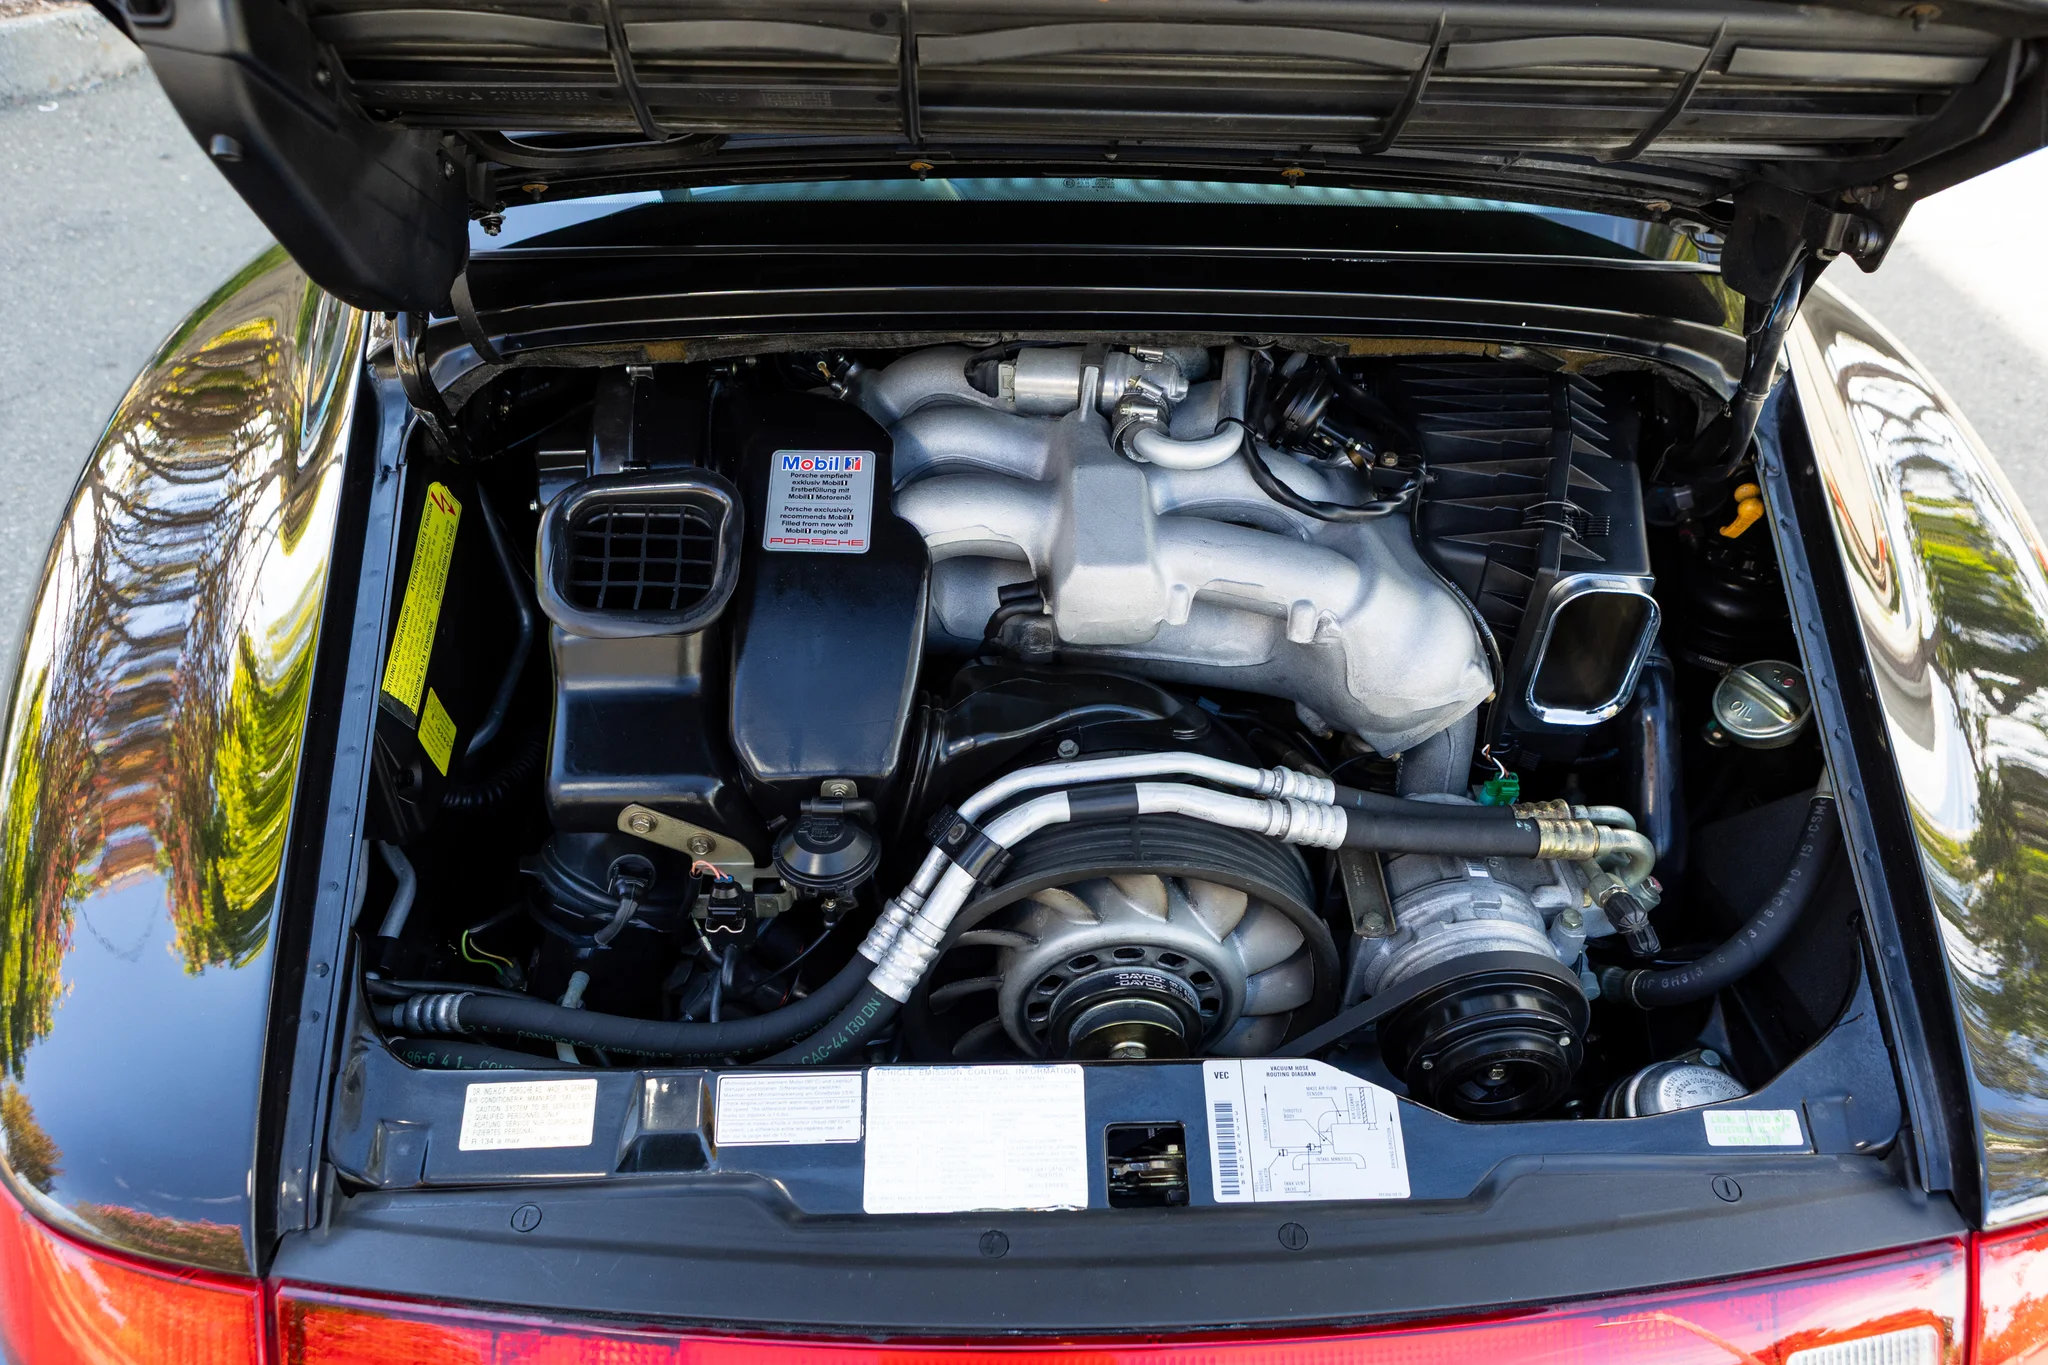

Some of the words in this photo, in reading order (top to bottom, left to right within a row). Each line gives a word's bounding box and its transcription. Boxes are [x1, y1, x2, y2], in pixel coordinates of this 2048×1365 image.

[782, 456, 839, 471] Mobil
[770, 538, 864, 546] PORSCHE
[393, 604, 410, 663] HOCHSPANNUNG
[410, 554, 422, 592] ATTENTION
[418, 530, 427, 553] HAUTE
[423, 501, 433, 529] TENSION
[423, 618, 434, 653] TENSIONE
[434, 571, 444, 601] DANGER
[444, 523, 454, 553] VOLTAGE
[1730, 700, 1753, 722] OIL
[845, 1015, 866, 1036] 130
[861, 997, 881, 1019] DN
[876, 1068, 914, 1076] VEHICLE
[1015, 1067, 1077, 1075] INFORMATION
[1214, 1071, 1230, 1079] VEC
